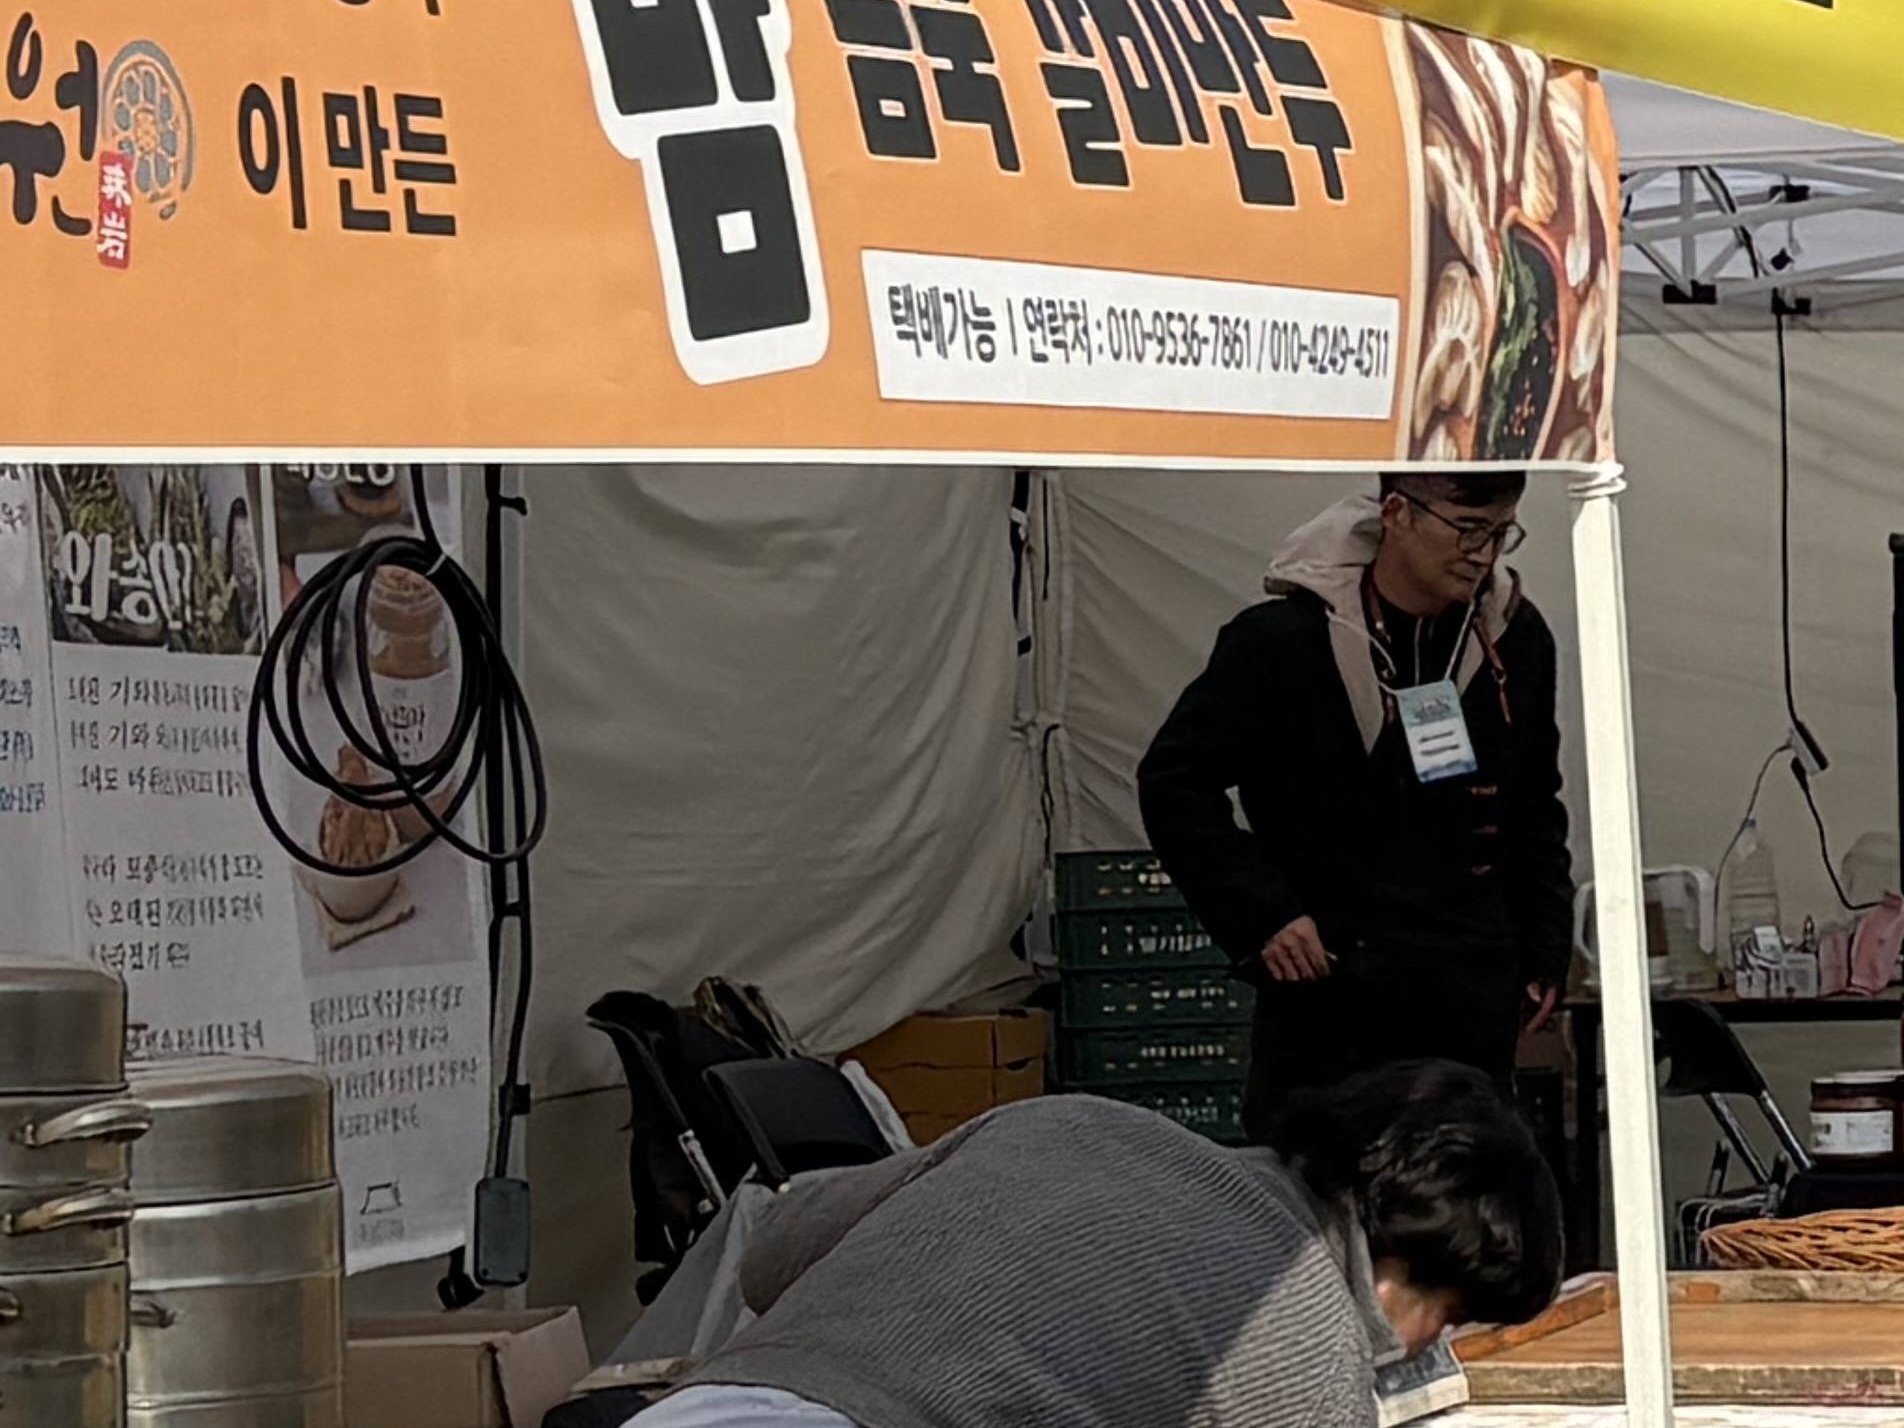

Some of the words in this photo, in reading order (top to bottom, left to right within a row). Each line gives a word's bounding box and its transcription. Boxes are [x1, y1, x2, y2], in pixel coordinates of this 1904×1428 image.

[237, 77, 308, 230] 이
[323, 85, 457, 237] 만든
[888, 283, 997, 363] 택배가능
[1107, 304, 1252, 371] 010-9536-7861
